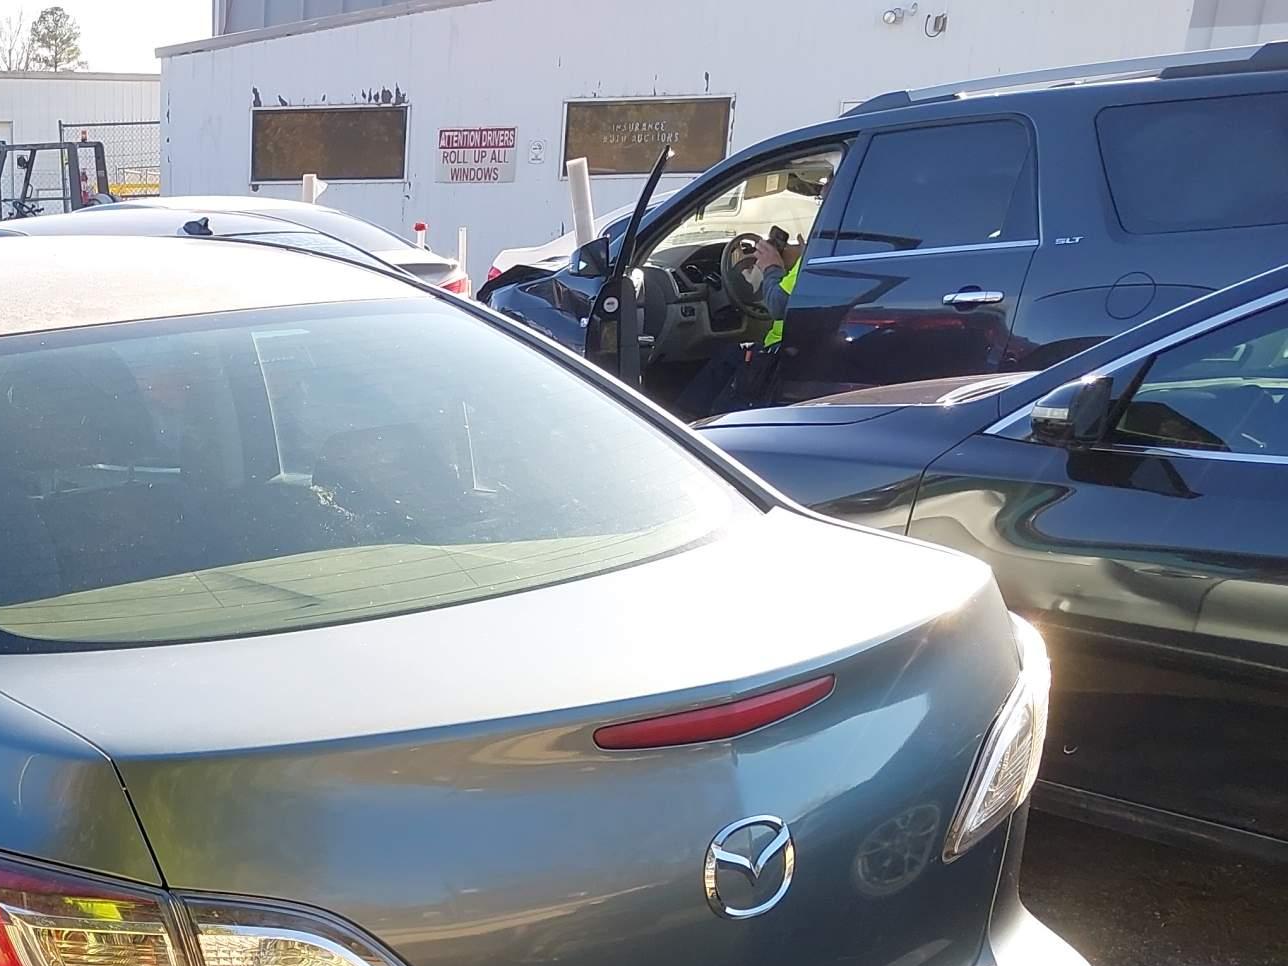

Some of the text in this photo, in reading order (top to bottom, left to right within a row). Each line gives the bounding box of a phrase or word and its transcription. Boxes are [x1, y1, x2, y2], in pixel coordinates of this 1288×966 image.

[612, 120, 666, 132] INSURANCE
[439, 130, 514, 148] ATTENTION DRIVERS
[442, 149, 510, 164] ROLL UP ALL
[450, 167, 499, 181] WINDOWS
[1055, 236, 1084, 245] SLT
